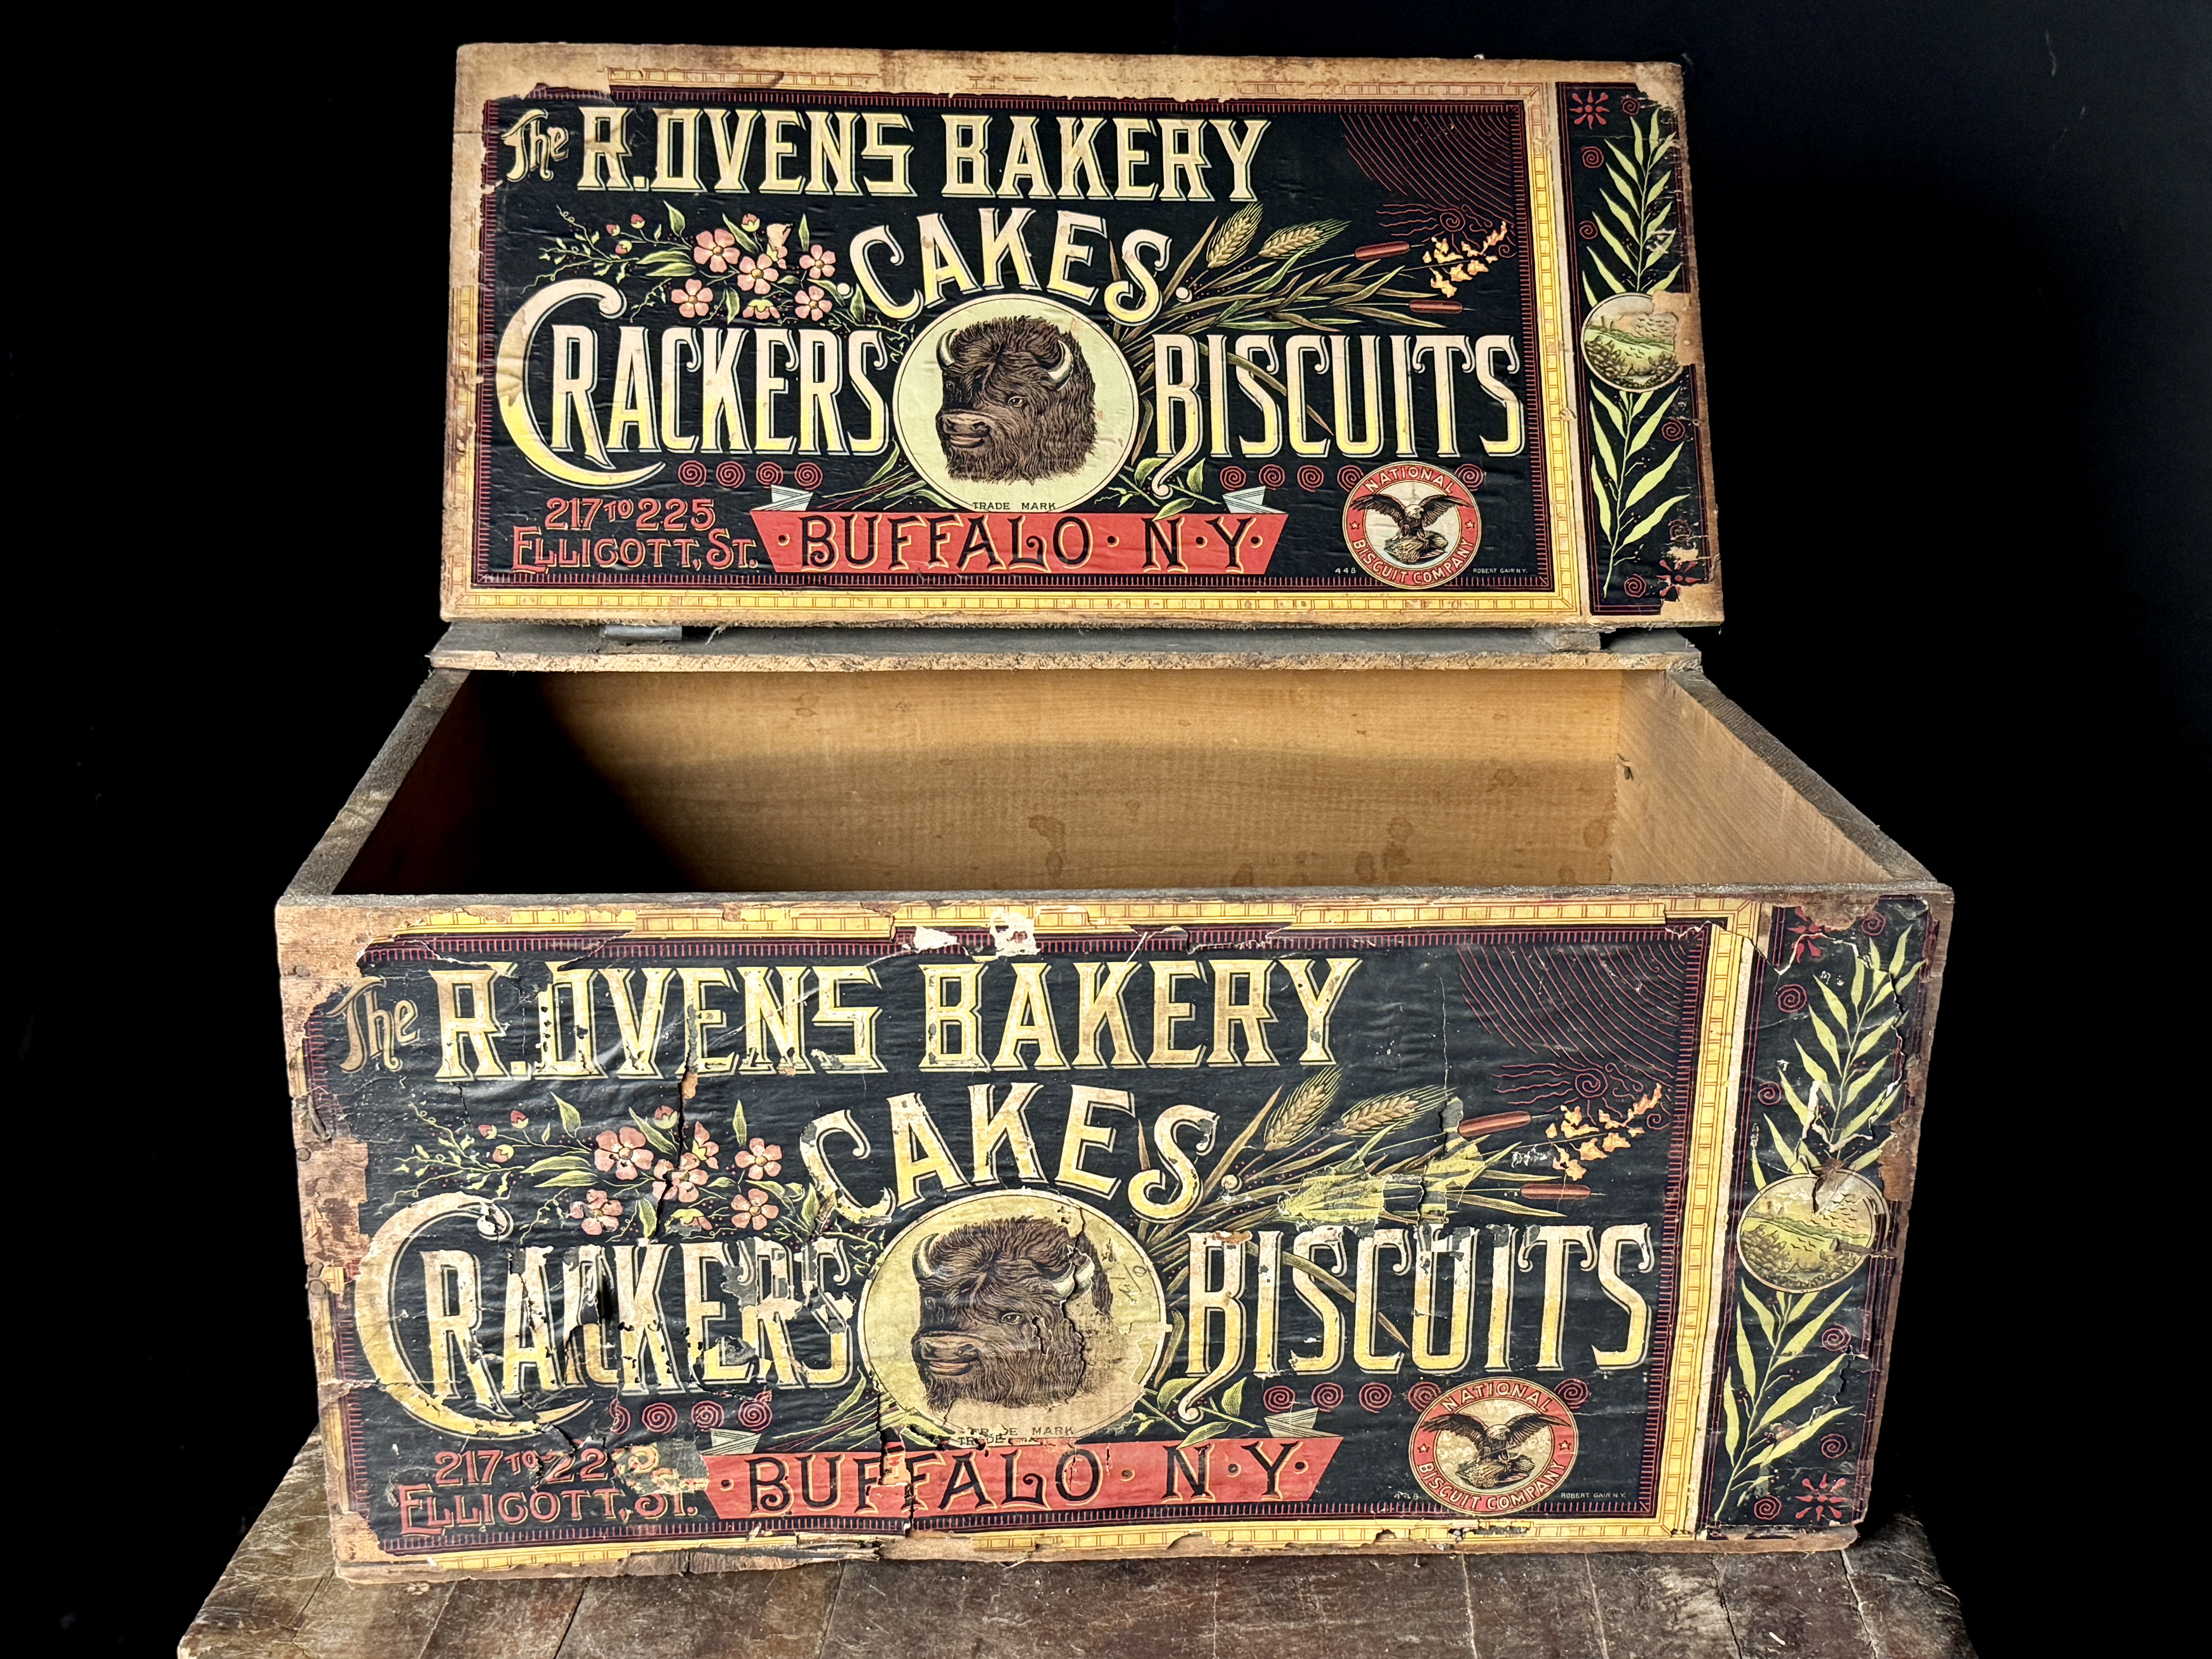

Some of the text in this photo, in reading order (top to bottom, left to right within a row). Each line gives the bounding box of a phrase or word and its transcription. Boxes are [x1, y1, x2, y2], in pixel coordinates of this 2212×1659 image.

[500, 109, 569, 182] The
[941, 113, 1271, 202] BAKERY
[850, 207, 1172, 326] CAKES
[496, 279, 889, 491] CRACKERS
[1151, 334, 1524, 498] BISCUITS
[1365, 465, 1454, 495] NATIONAL
[544, 497, 603, 531] 217
[636, 498, 715, 532] 225
[798, 513, 1093, 573] BUFFALO
[1352, 539, 1475, 585] BISCUIT COMPANY
[329, 975, 421, 1072] The
[919, 958, 1363, 1071] BAKERY
[799, 1082, 1219, 1224] CAKES
[1185, 1223, 1654, 1424] BISCUITS
[1441, 1381, 1554, 1412] NATIONAL
[1032, 1427, 1075, 1436] MARK
[434, 1448, 504, 1487] 217
[745, 1449, 1103, 1517] BUFFALO
[1419, 1461, 1567, 1510] BISCUIT COMPANY
